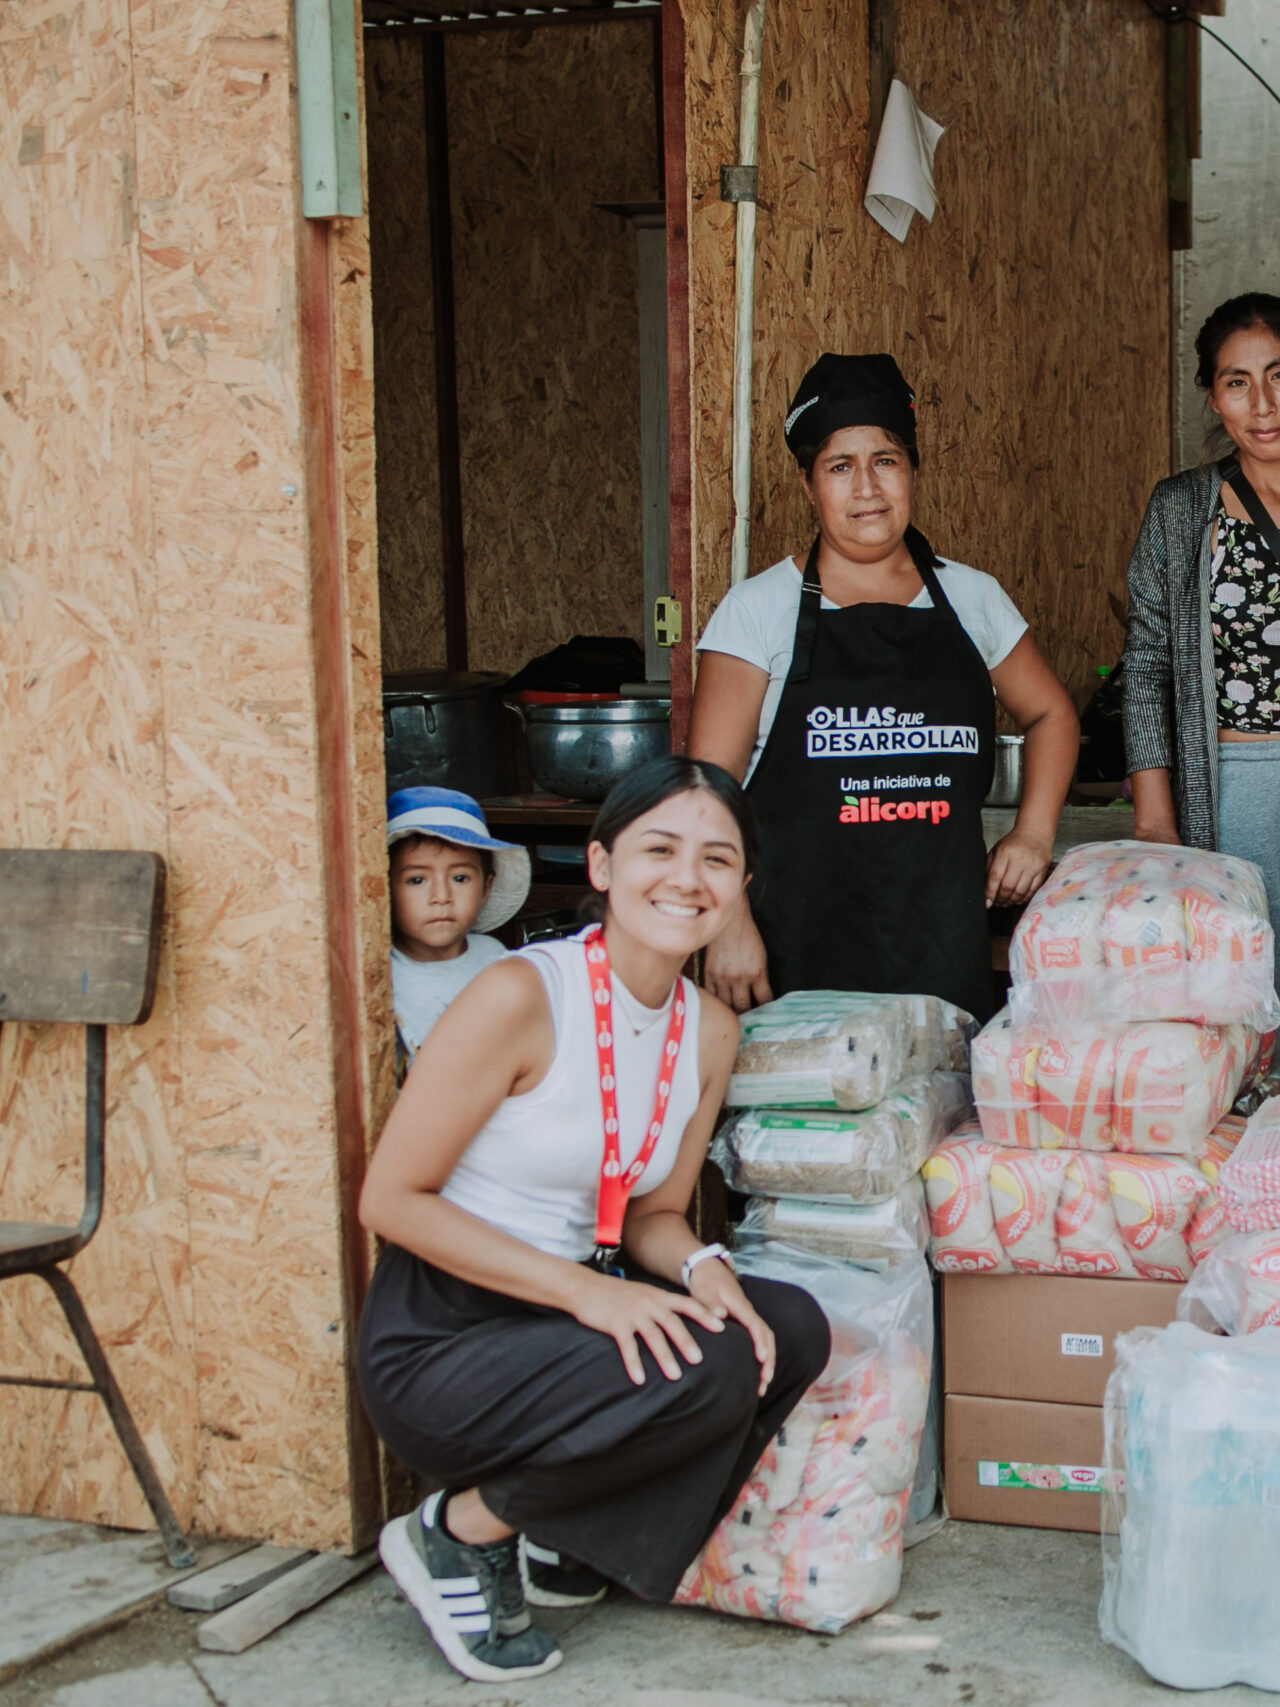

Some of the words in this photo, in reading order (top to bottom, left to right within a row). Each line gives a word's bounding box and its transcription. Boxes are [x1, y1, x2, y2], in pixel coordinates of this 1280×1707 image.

[807, 706, 896, 729] OLLAS
[897, 712, 925, 728] que
[812, 730, 976, 752] DESARROLLAN
[840, 777, 870, 791] Una
[873, 775, 931, 790] iniciativa
[934, 773, 951, 787] de
